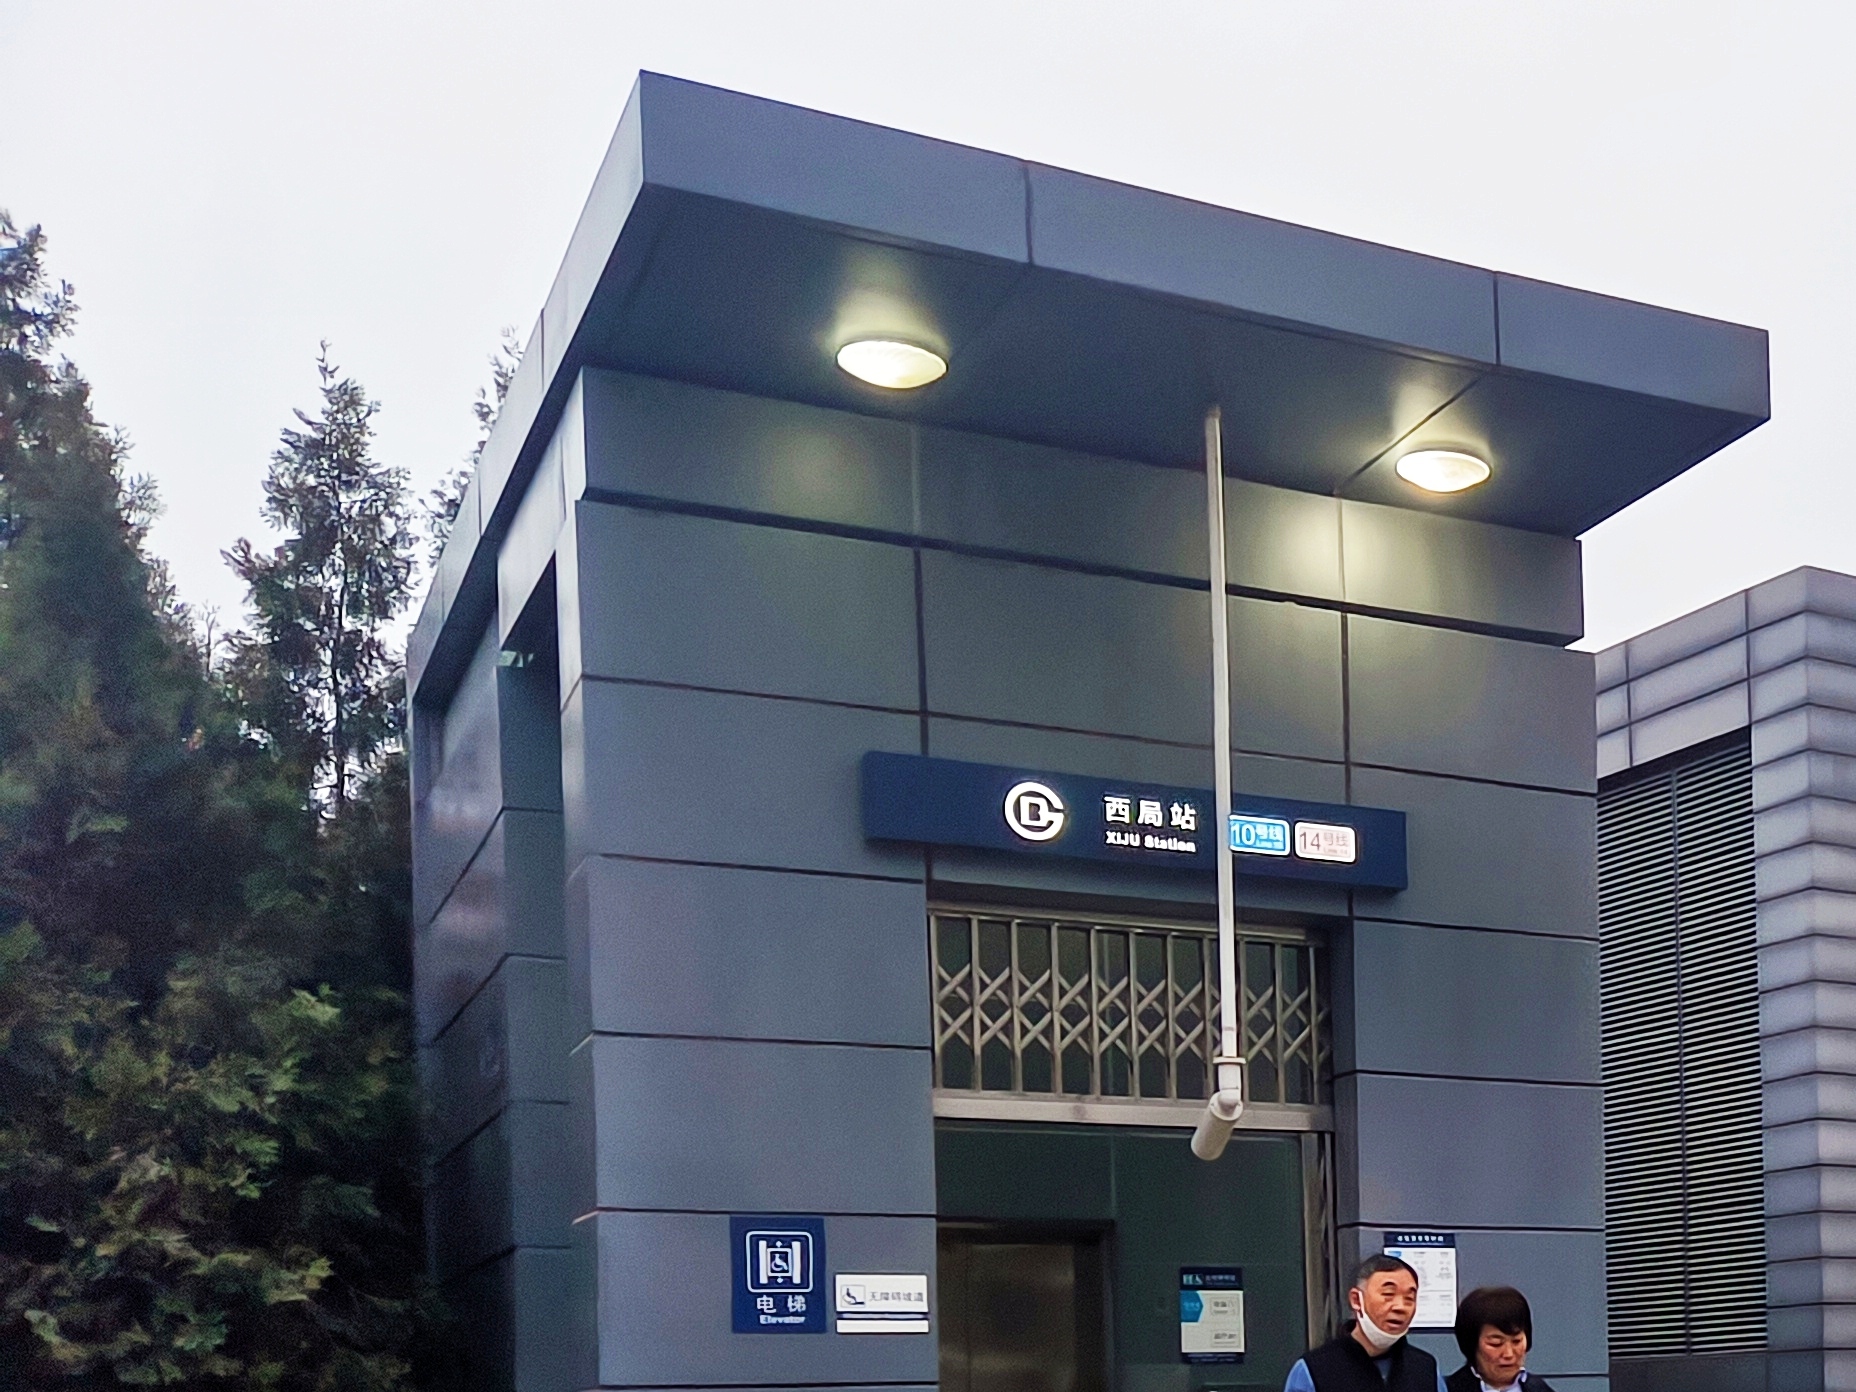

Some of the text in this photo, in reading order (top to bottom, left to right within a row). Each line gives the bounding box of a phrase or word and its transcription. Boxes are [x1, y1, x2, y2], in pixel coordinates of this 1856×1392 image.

[1103, 796, 1197, 830] 西局站
[1105, 831, 1197, 853] XIJU Station
[756, 1294, 806, 1314] 电梯
[759, 1315, 806, 1324] Elevator
